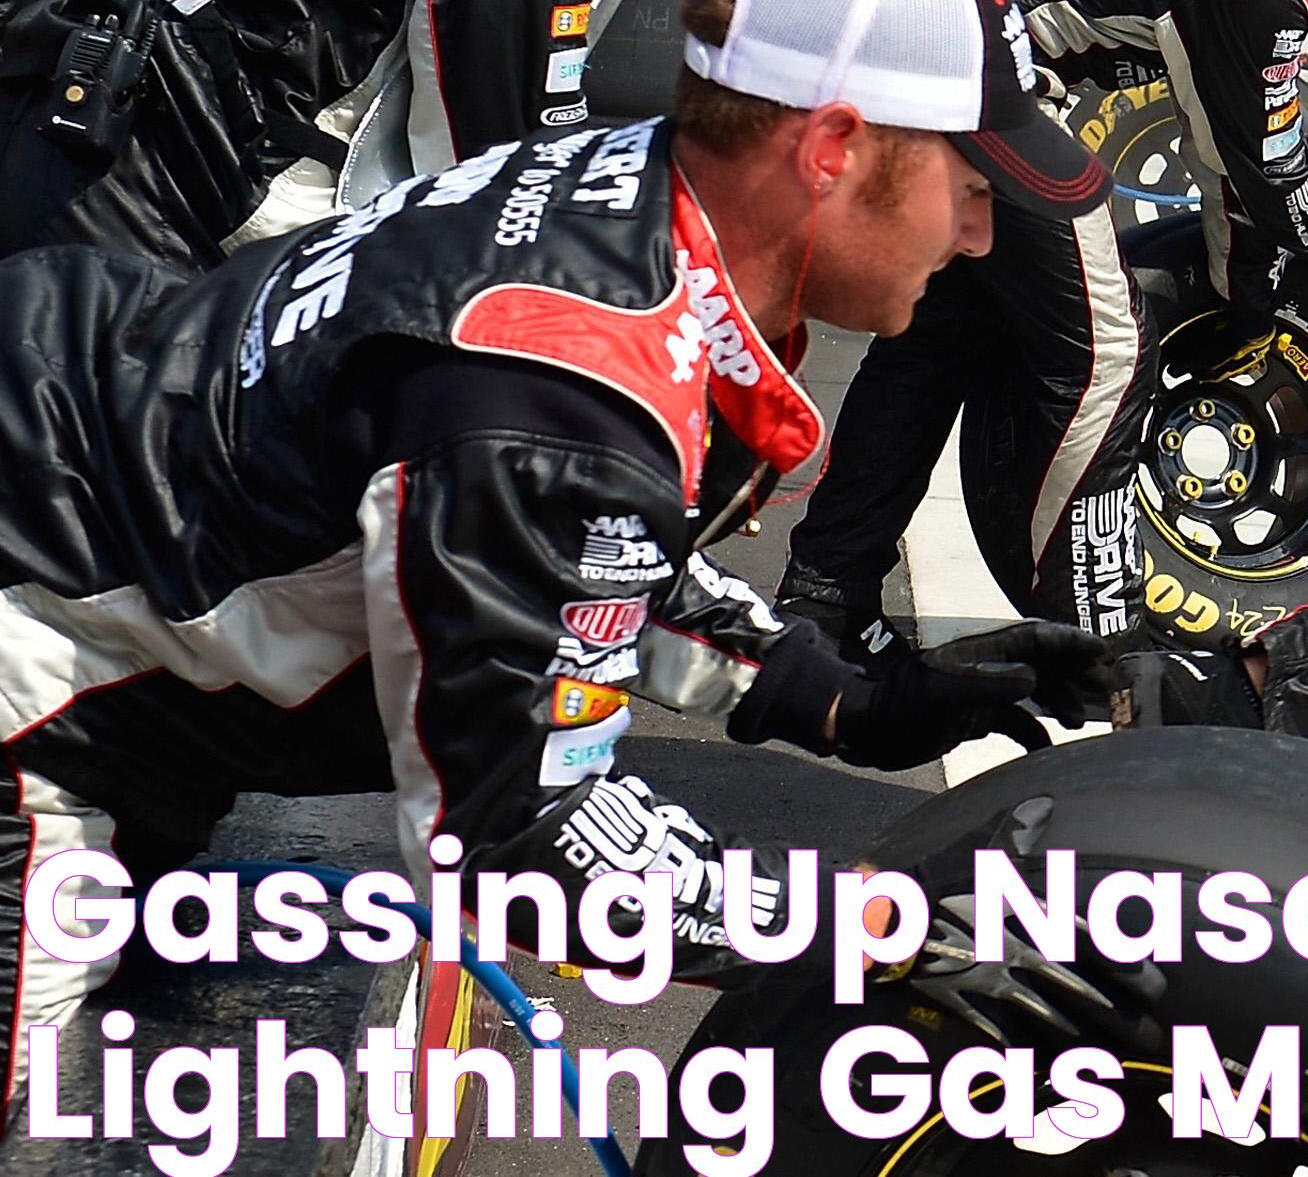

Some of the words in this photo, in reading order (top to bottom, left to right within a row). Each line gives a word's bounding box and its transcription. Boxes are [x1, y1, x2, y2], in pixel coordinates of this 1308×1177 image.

[495, 179, 550, 247] 50555
[1071, 497, 1087, 521] TO
[1071, 524, 1087, 563] END
[1087, 487, 1129, 638] DRIVE
